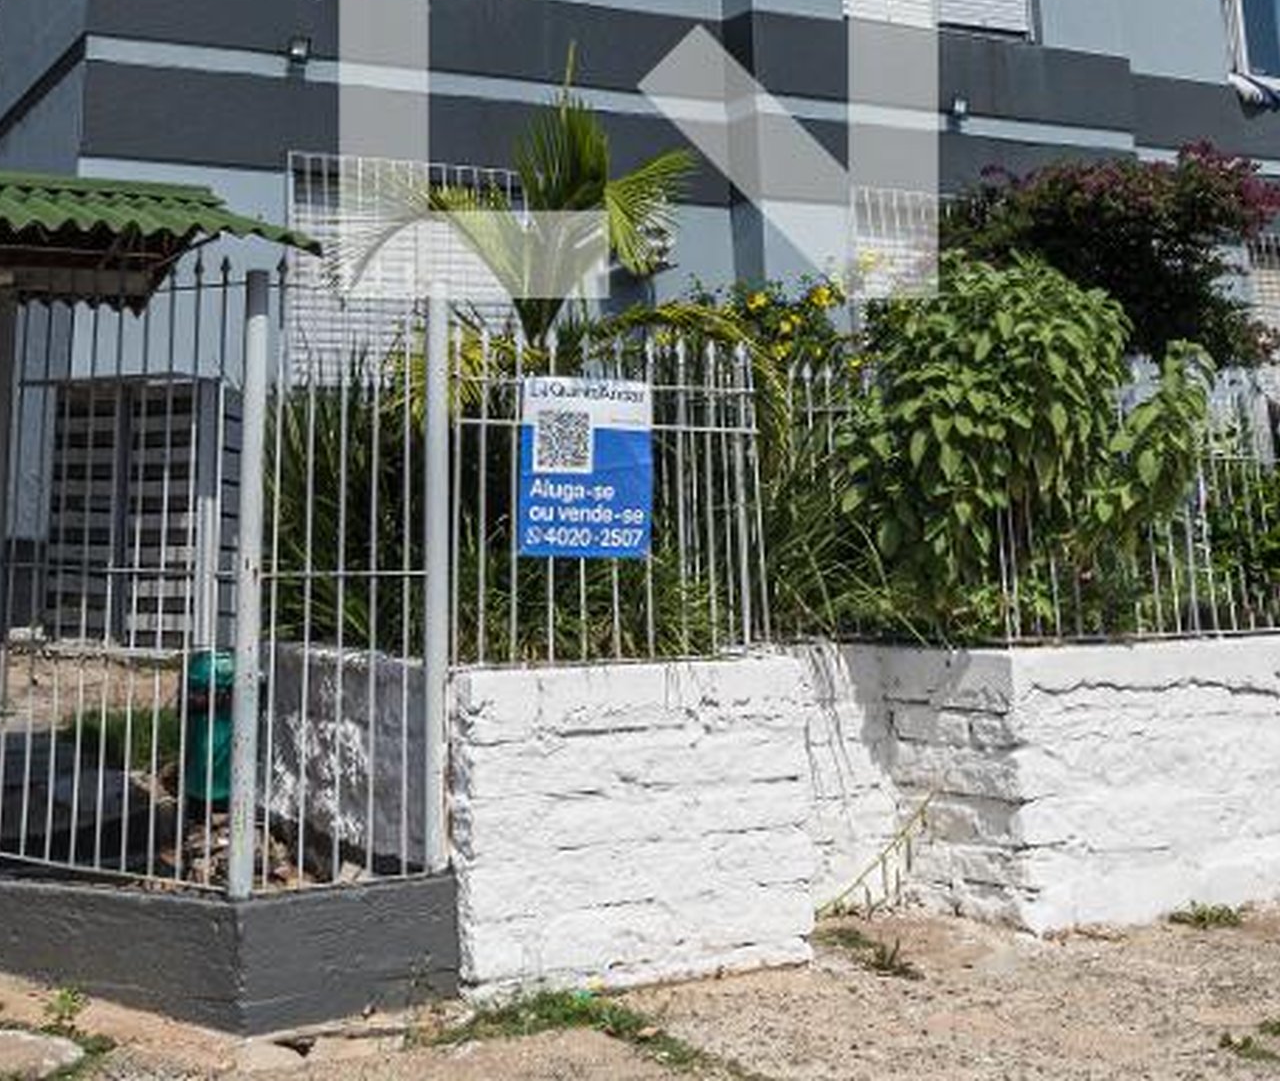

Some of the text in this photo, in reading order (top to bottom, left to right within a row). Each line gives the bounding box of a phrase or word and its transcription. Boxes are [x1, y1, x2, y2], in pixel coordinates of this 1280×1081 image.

[530, 479, 615, 501] Aluga-se
[529, 505, 644, 524] ou vende-se
[544, 528, 644, 547] 4020-2507
